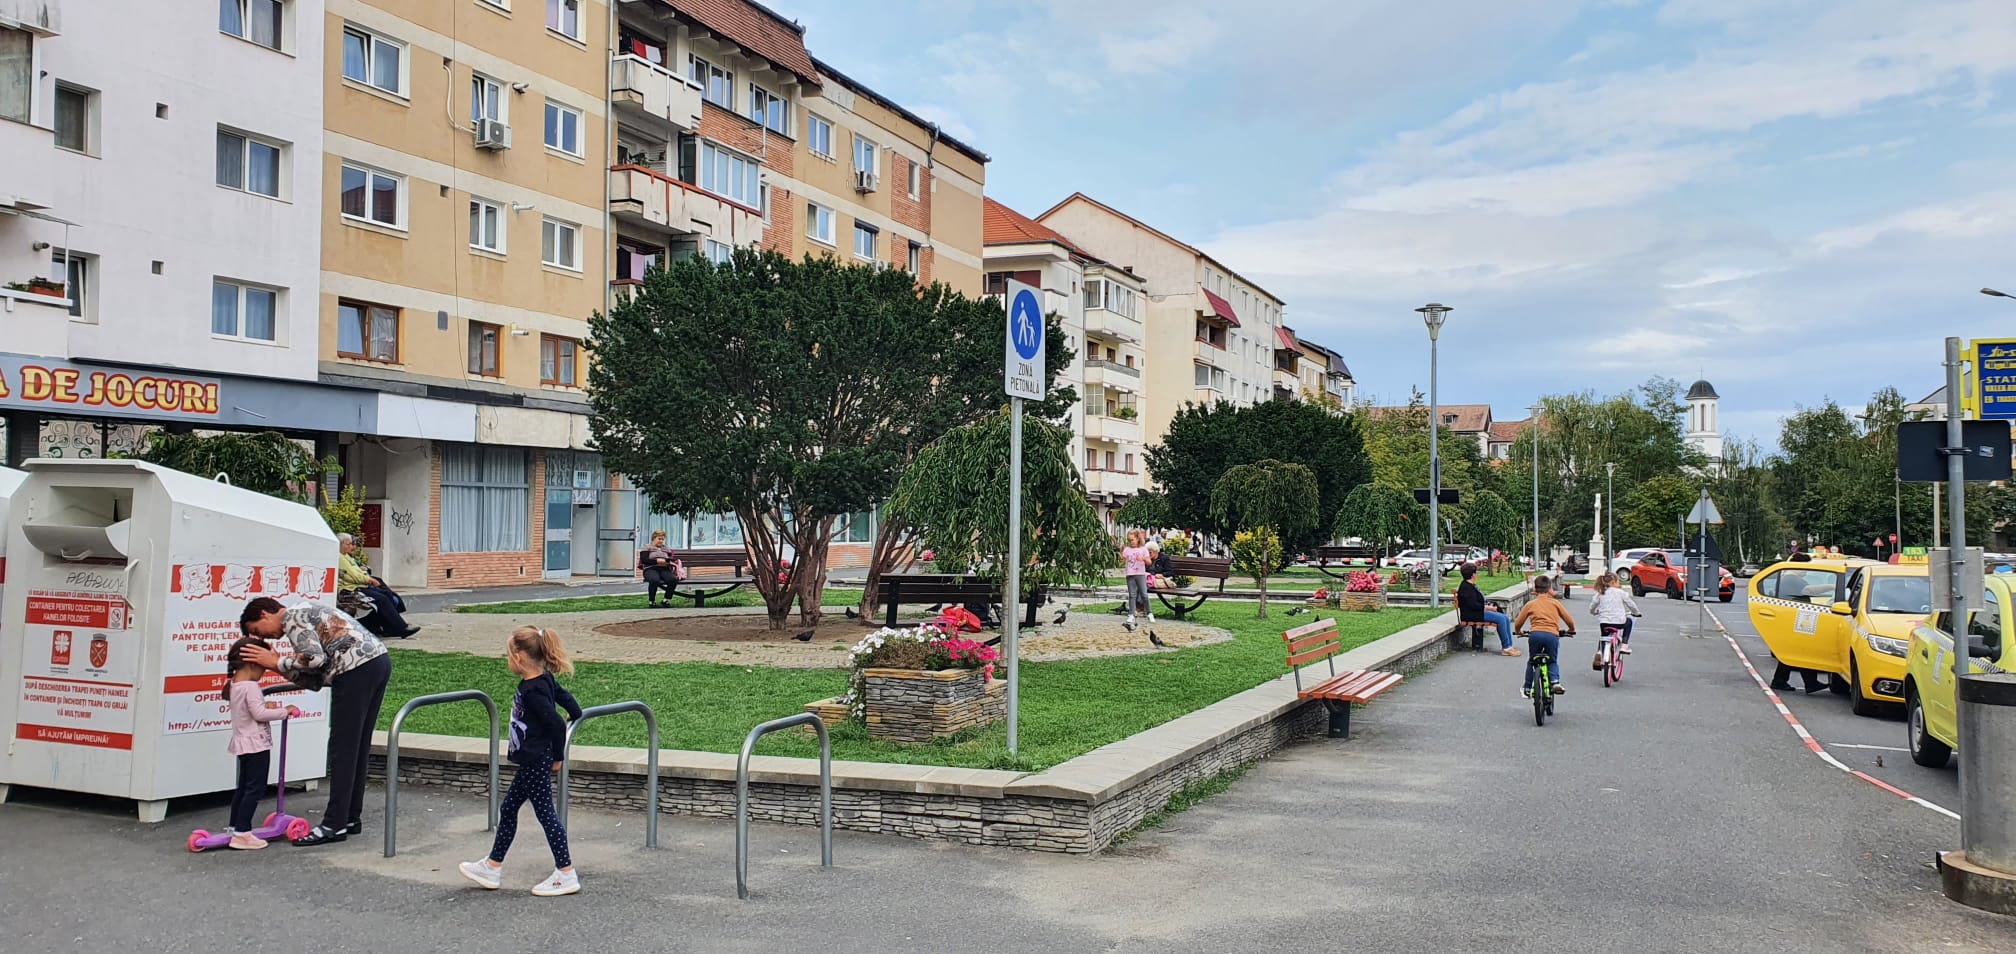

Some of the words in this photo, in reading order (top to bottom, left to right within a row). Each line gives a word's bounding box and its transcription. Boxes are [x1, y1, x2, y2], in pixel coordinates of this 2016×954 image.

[1019, 363, 1033, 377] ZONĂ
[20, 365, 80, 402] DE
[83, 372, 219, 414] JOCURI
[1010, 377, 1040, 394] PIETONALĂ
[29, 601, 55, 610] CONTAINER
[56, 602, 75, 611] PENTRU
[75, 604, 106, 614] COLECTAREA
[43, 613, 67, 622] HAINELOR
[67, 614, 91, 623] FOLOSITE
[198, 621, 231, 629] RUGĂM
[172, 633, 219, 641] PANTOFII,
[25, 680, 38, 690] DUPĂ
[38, 683, 71, 692] DESCHIDEREA
[71, 685, 89, 694] TRAPEI
[89, 687, 107, 697] PUNEȚI
[107, 688, 129, 698] HAINELE
[30, 694, 56, 704] CONTAINER
[62, 696, 87, 709] ÎNCHIDEȚI
[87, 698, 103, 708] TRAPA
[103, 700, 111, 708] CU
[38, 728, 46, 738] SĂ
[47, 730, 73, 740] AJUTĂM
[73, 732, 109, 744] ÎMPREUNĂ!
